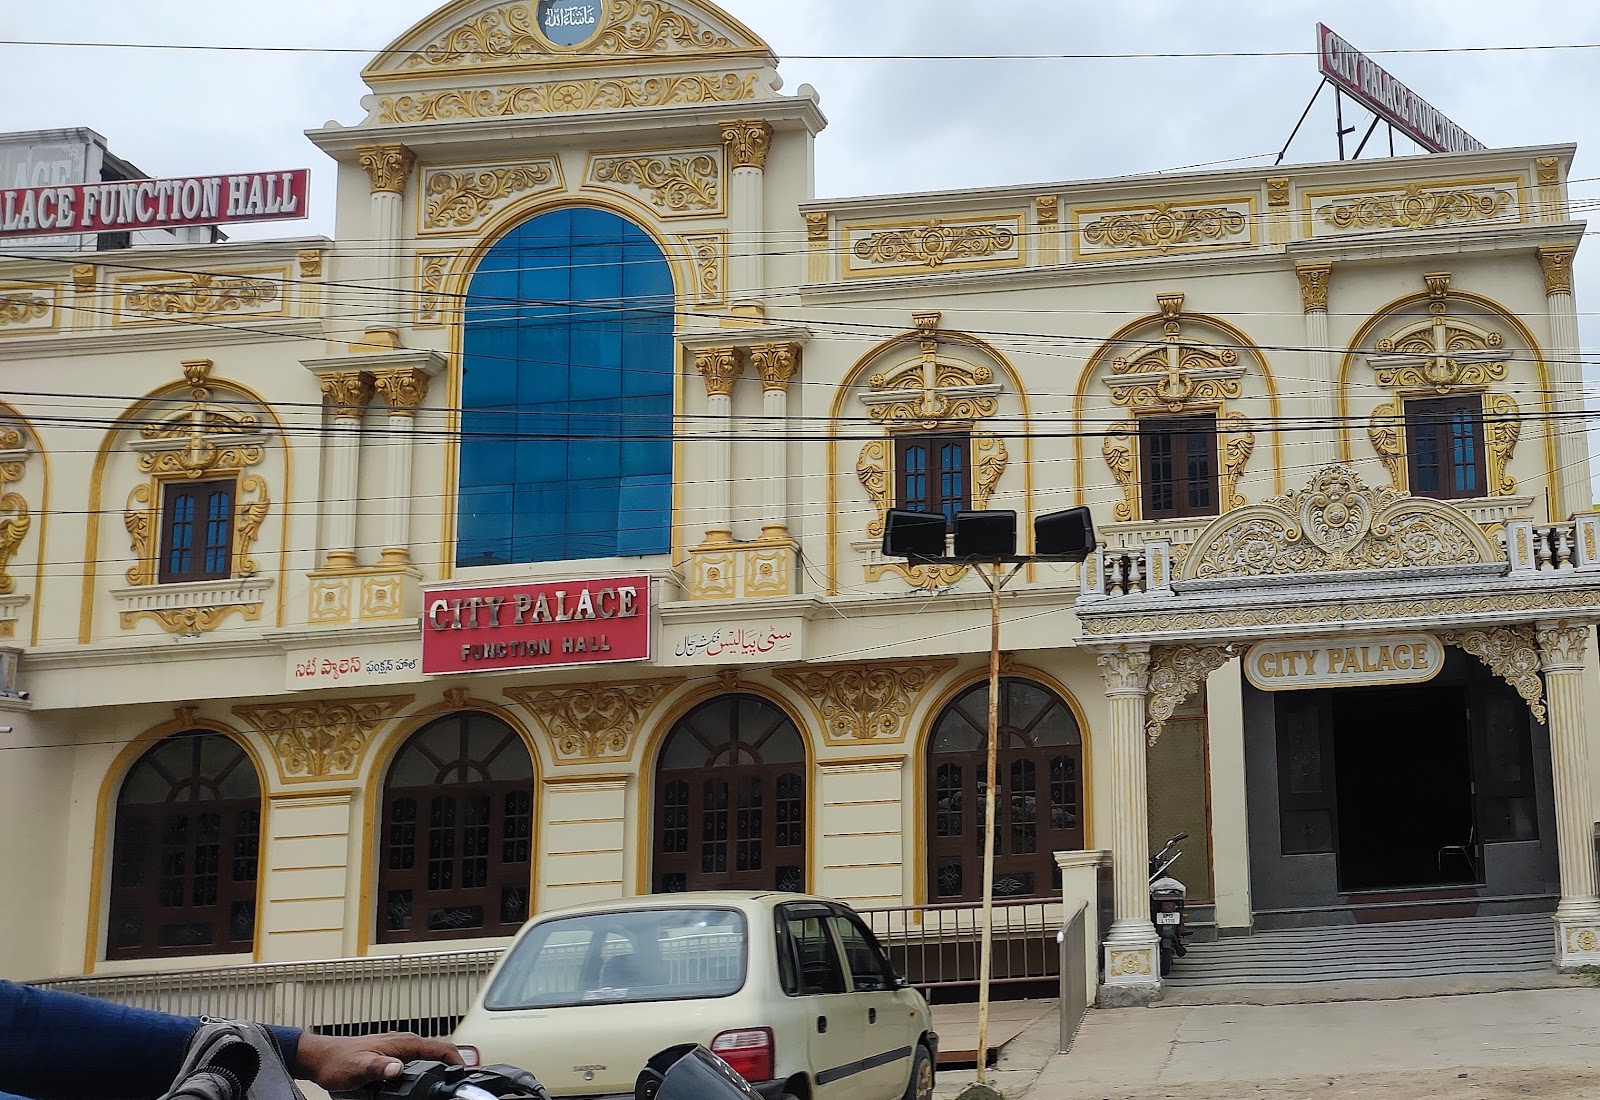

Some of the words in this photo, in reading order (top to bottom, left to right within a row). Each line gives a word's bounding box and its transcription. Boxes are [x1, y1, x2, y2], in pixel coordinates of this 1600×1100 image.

[1325, 32, 1359, 86] CITY
[1359, 54, 1409, 121] PALACE
[1408, 92, 1465, 152] FUNCTION
[0, 187, 76, 231] LACE
[81, 177, 222, 228] FUNCTION
[227, 172, 297, 216] HALL
[429, 596, 504, 630] CITY
[513, 586, 637, 624] PALACE
[460, 637, 551, 661] FUNCTION
[562, 635, 611, 653] HALL
[1258, 650, 1318, 677] CITY
[1327, 644, 1428, 674] PALACE
